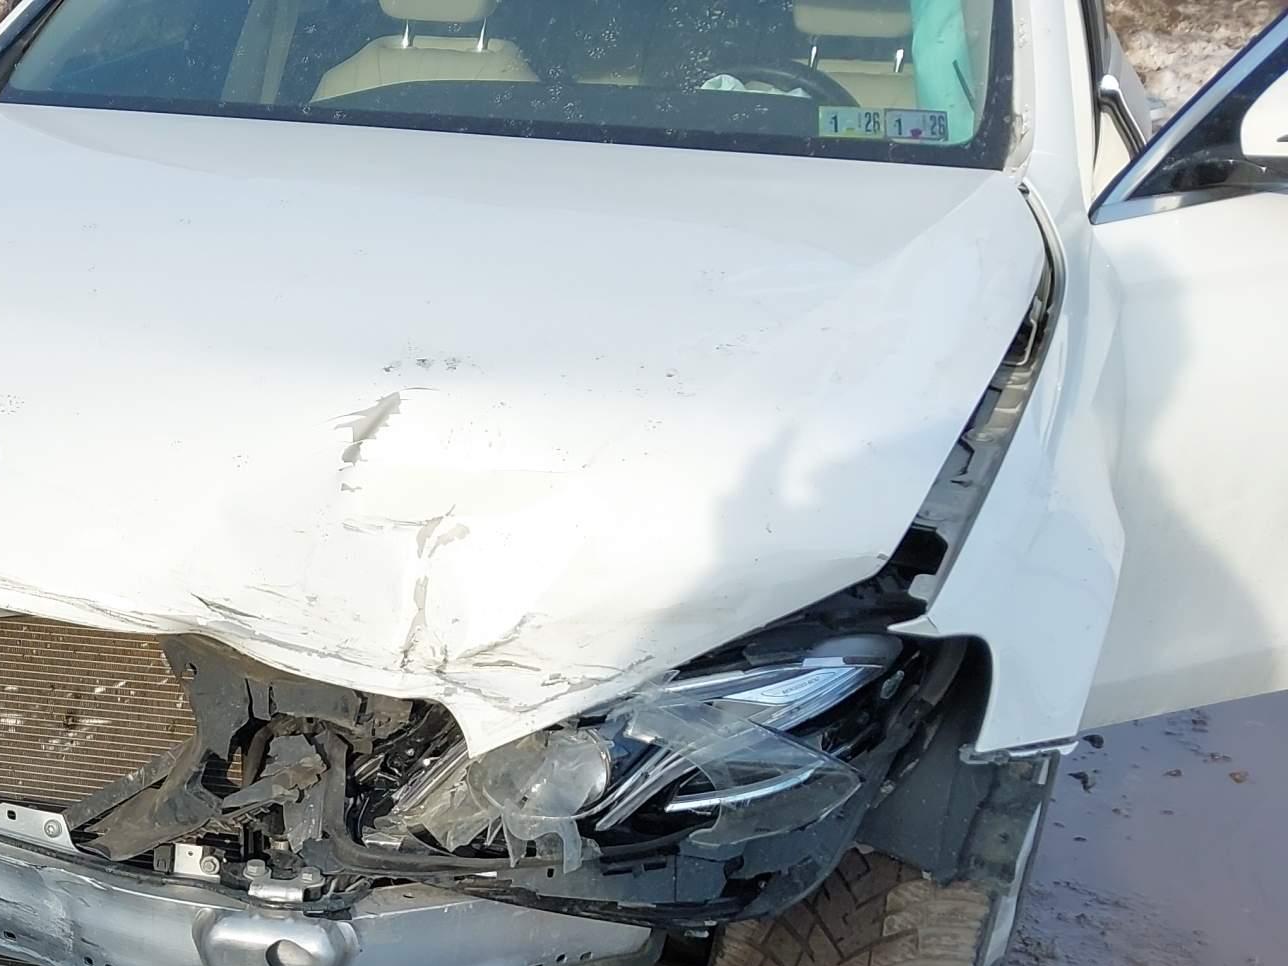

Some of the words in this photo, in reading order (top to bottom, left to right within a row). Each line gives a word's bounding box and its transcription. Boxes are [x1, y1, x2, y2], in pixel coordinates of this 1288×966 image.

[831, 114, 839, 133] 1
[864, 111, 881, 134] 26
[894, 117, 903, 136] 1
[927, 114, 945, 136] 26
